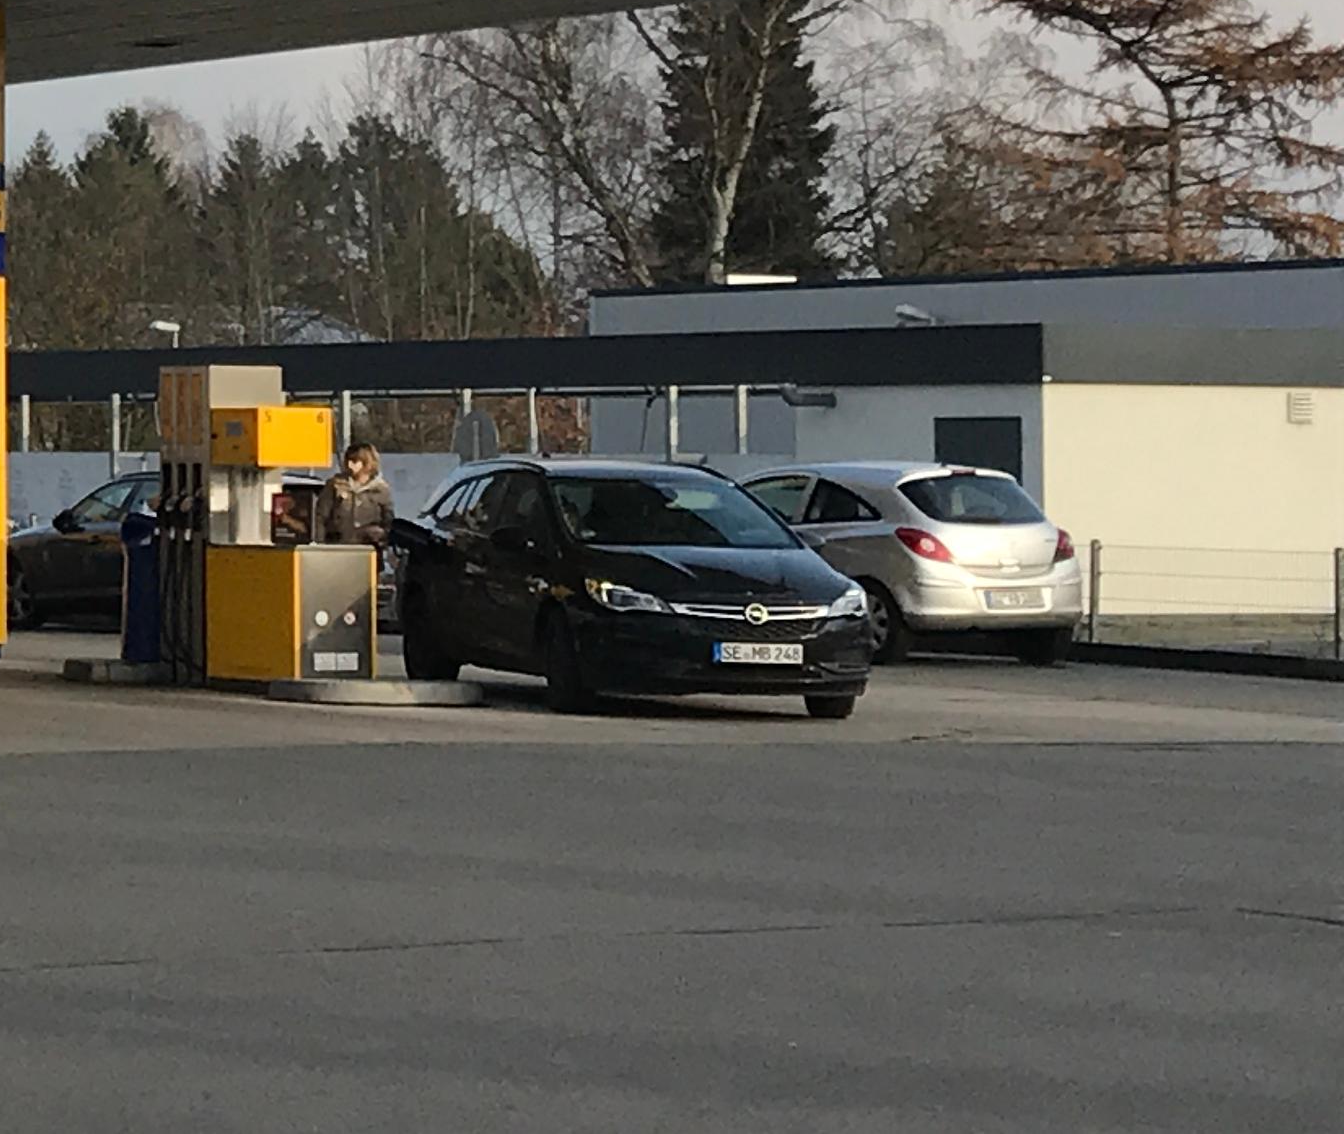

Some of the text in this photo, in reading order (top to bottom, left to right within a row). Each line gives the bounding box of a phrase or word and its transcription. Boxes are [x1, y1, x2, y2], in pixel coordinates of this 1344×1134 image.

[316, 411, 325, 424] 6
[722, 645, 742, 660] SE
[774, 646, 801, 661] 248
